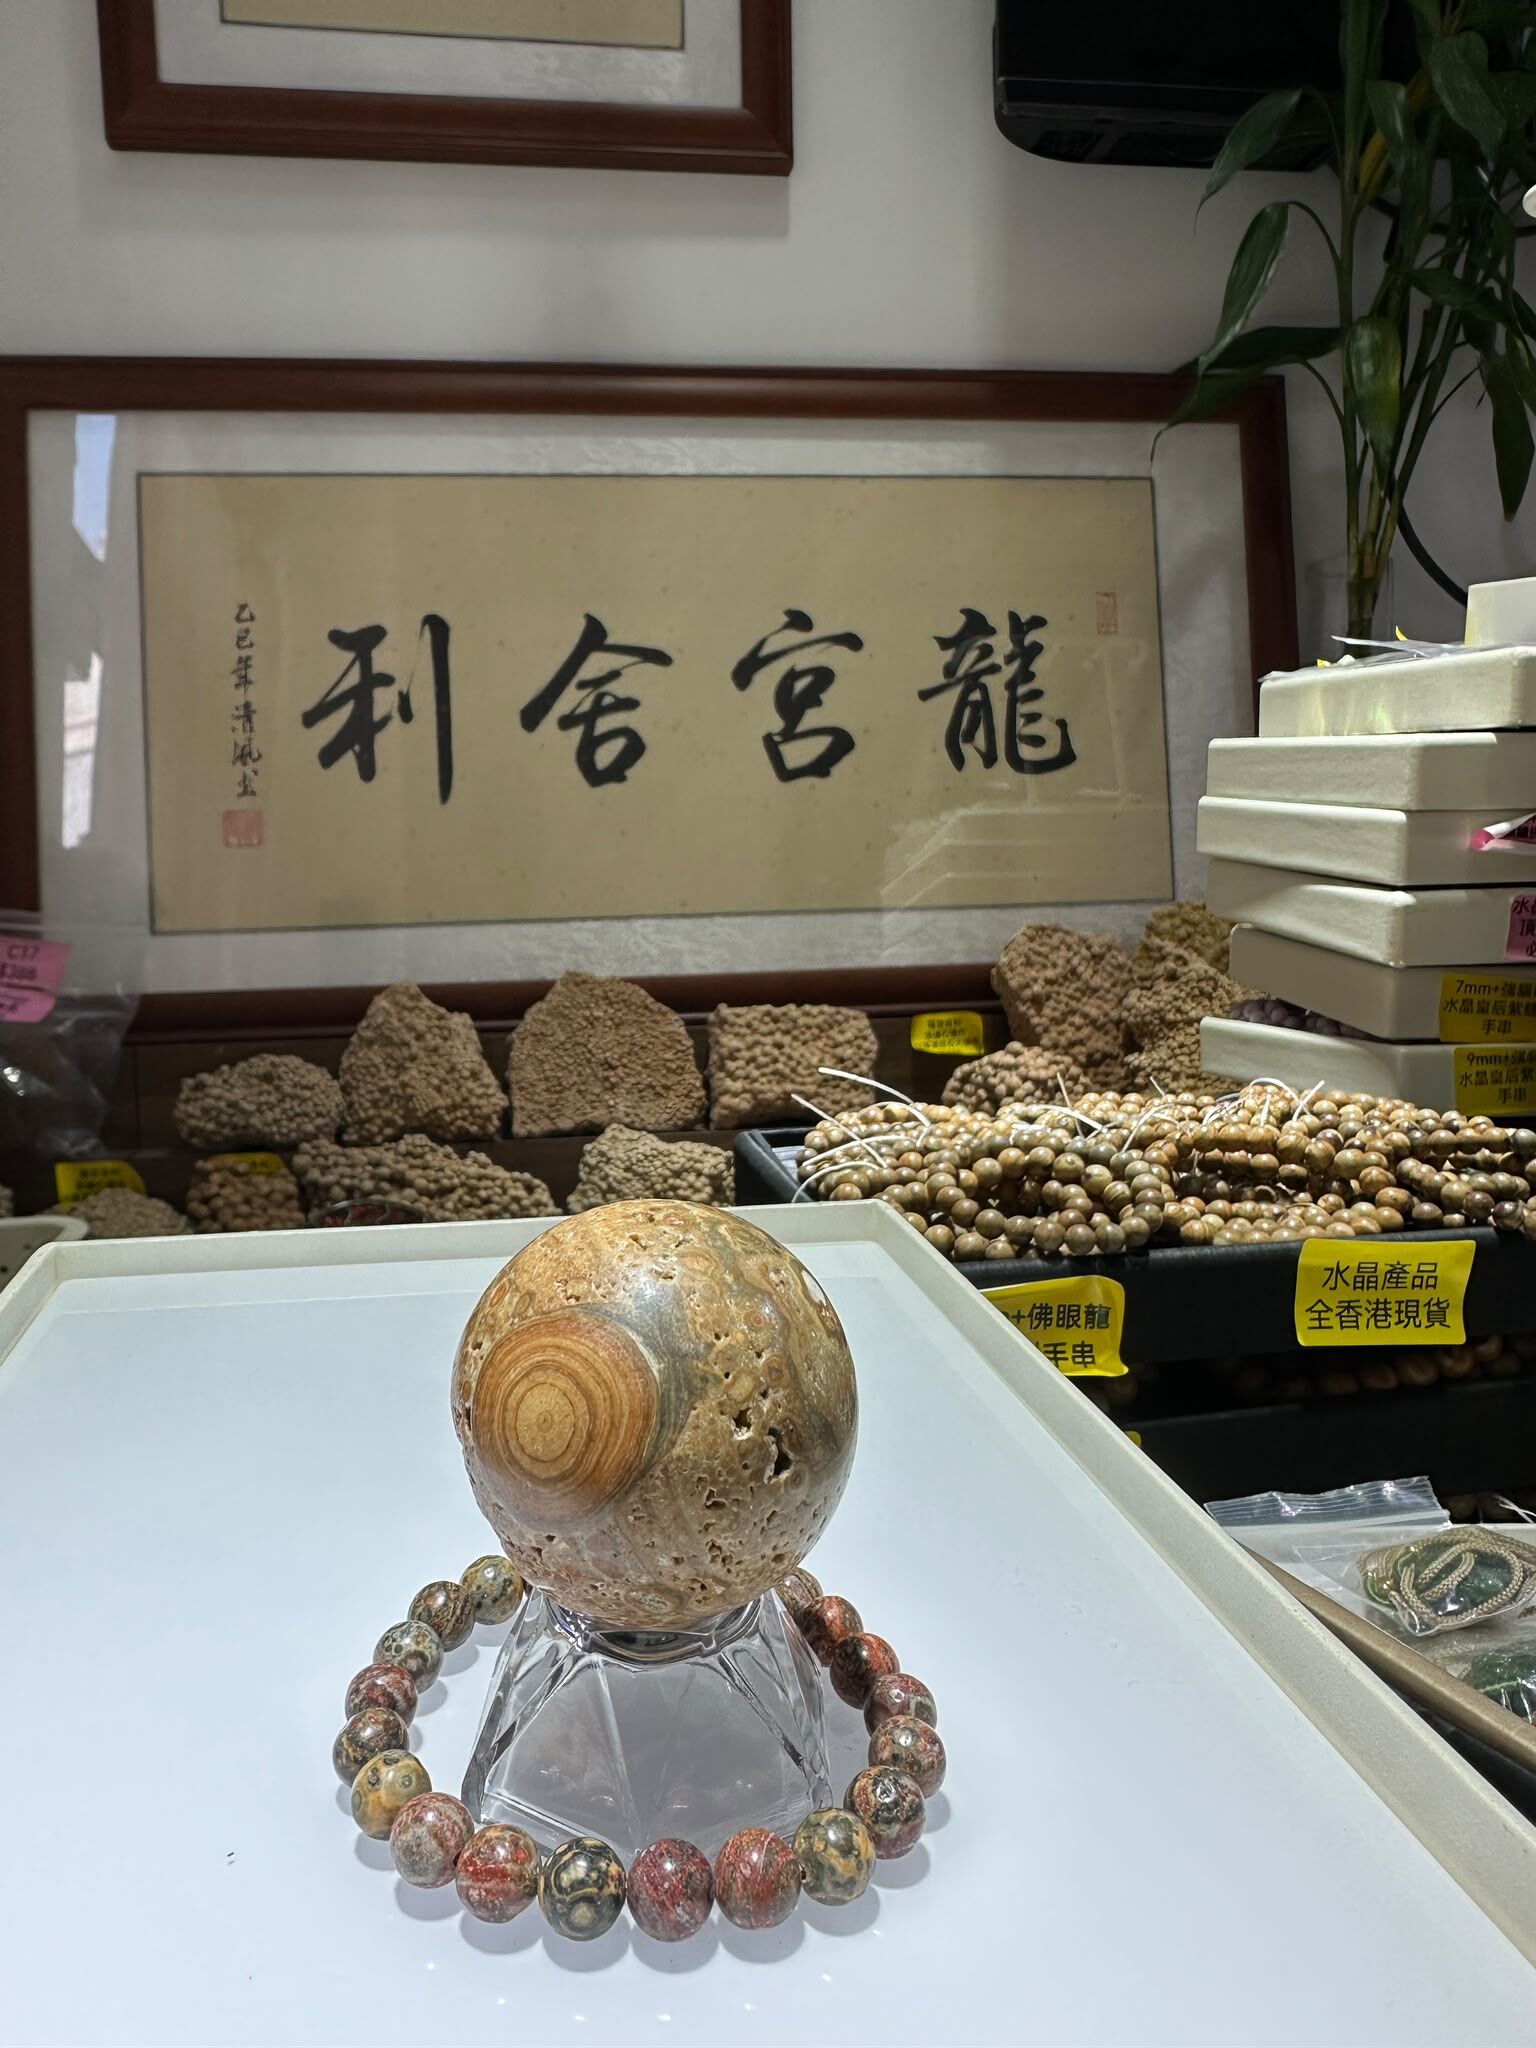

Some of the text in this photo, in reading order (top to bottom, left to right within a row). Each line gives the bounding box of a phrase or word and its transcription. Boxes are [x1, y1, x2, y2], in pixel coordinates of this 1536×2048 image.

[1321, 1260, 1438, 1291] 水晶產品
[1305, 1297, 1451, 1330] 全香港現貨
[1036, 1340, 1096, 1369] 手串
